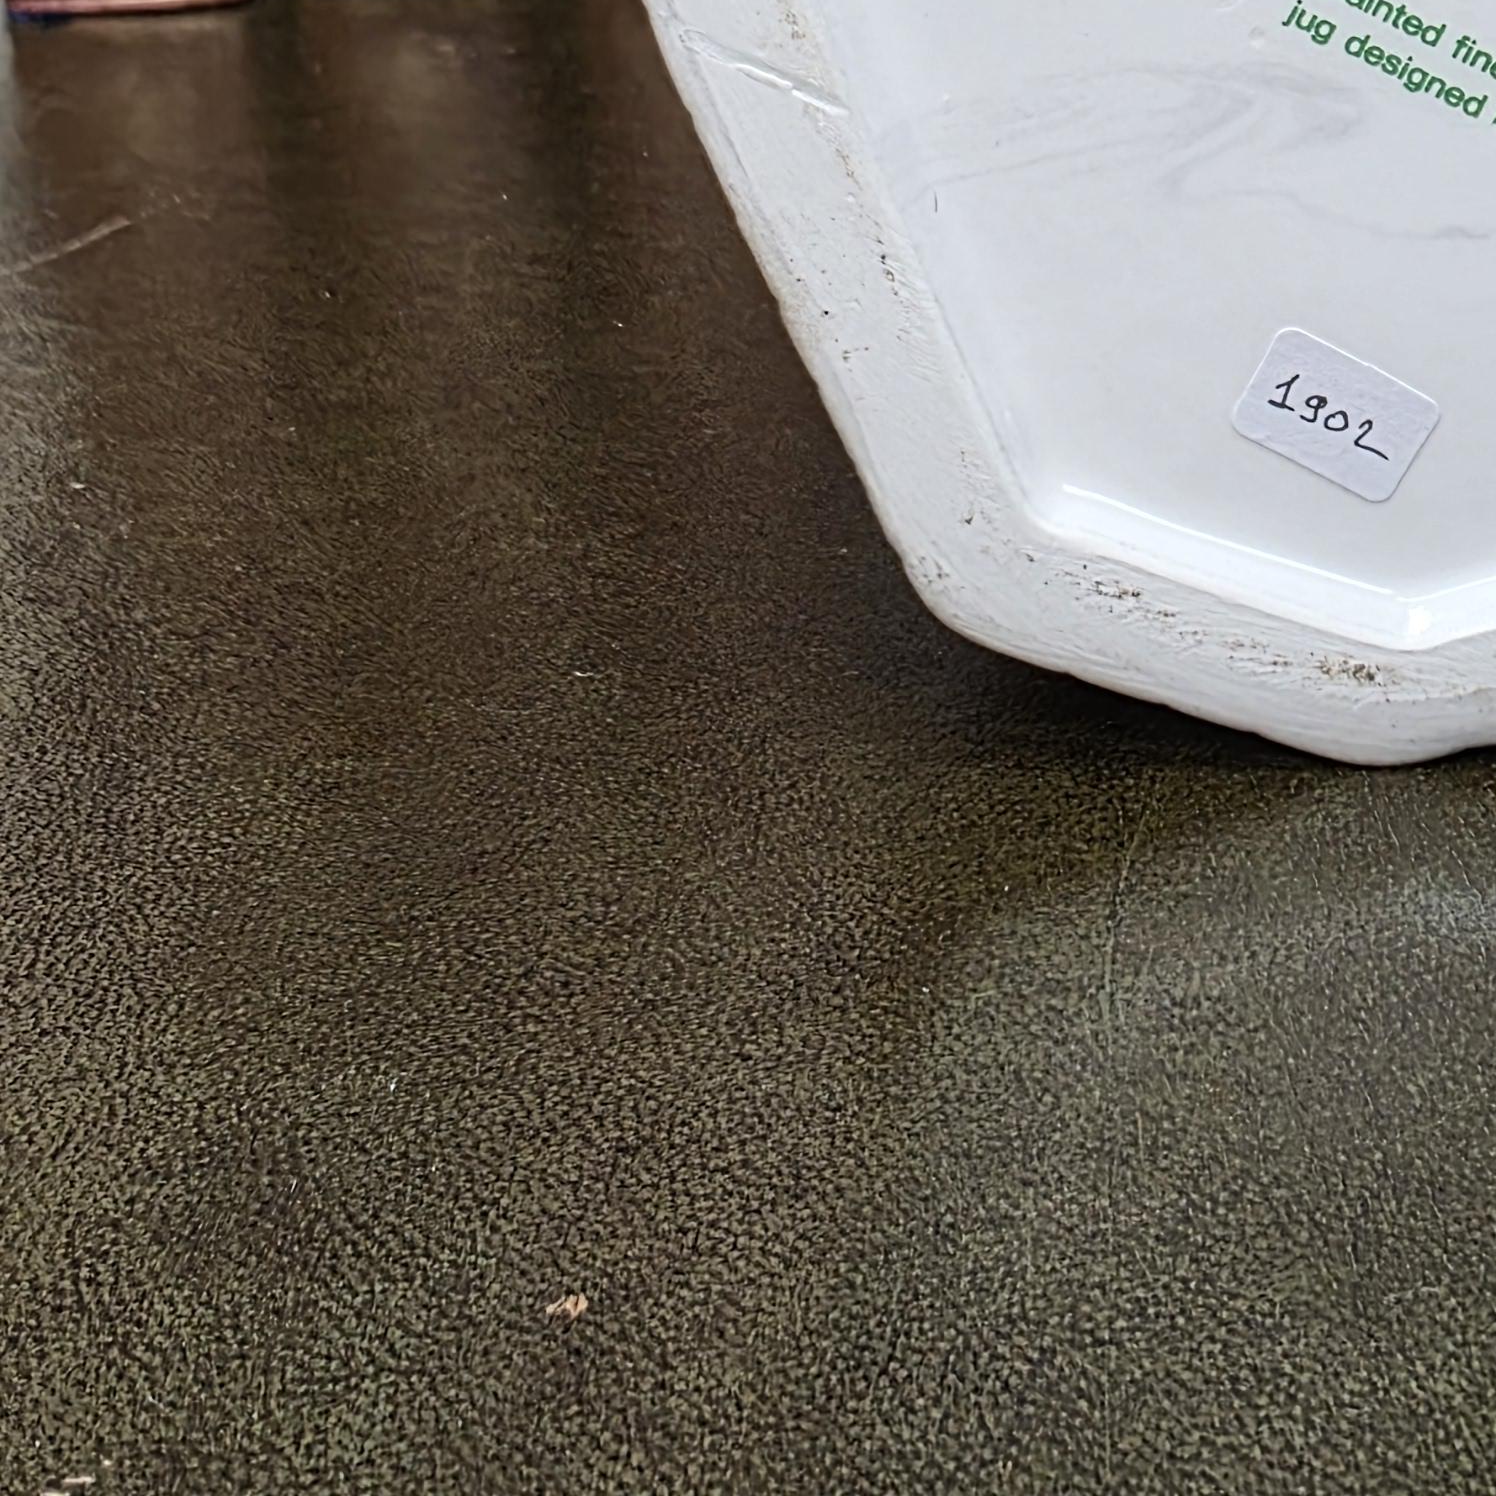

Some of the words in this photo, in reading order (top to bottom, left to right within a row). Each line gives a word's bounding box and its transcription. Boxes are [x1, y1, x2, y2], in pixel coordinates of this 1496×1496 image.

[1281, 0, 1338, 46] jug
[1344, 34, 1489, 119] designed
[1267, 373, 1390, 462] 1902
